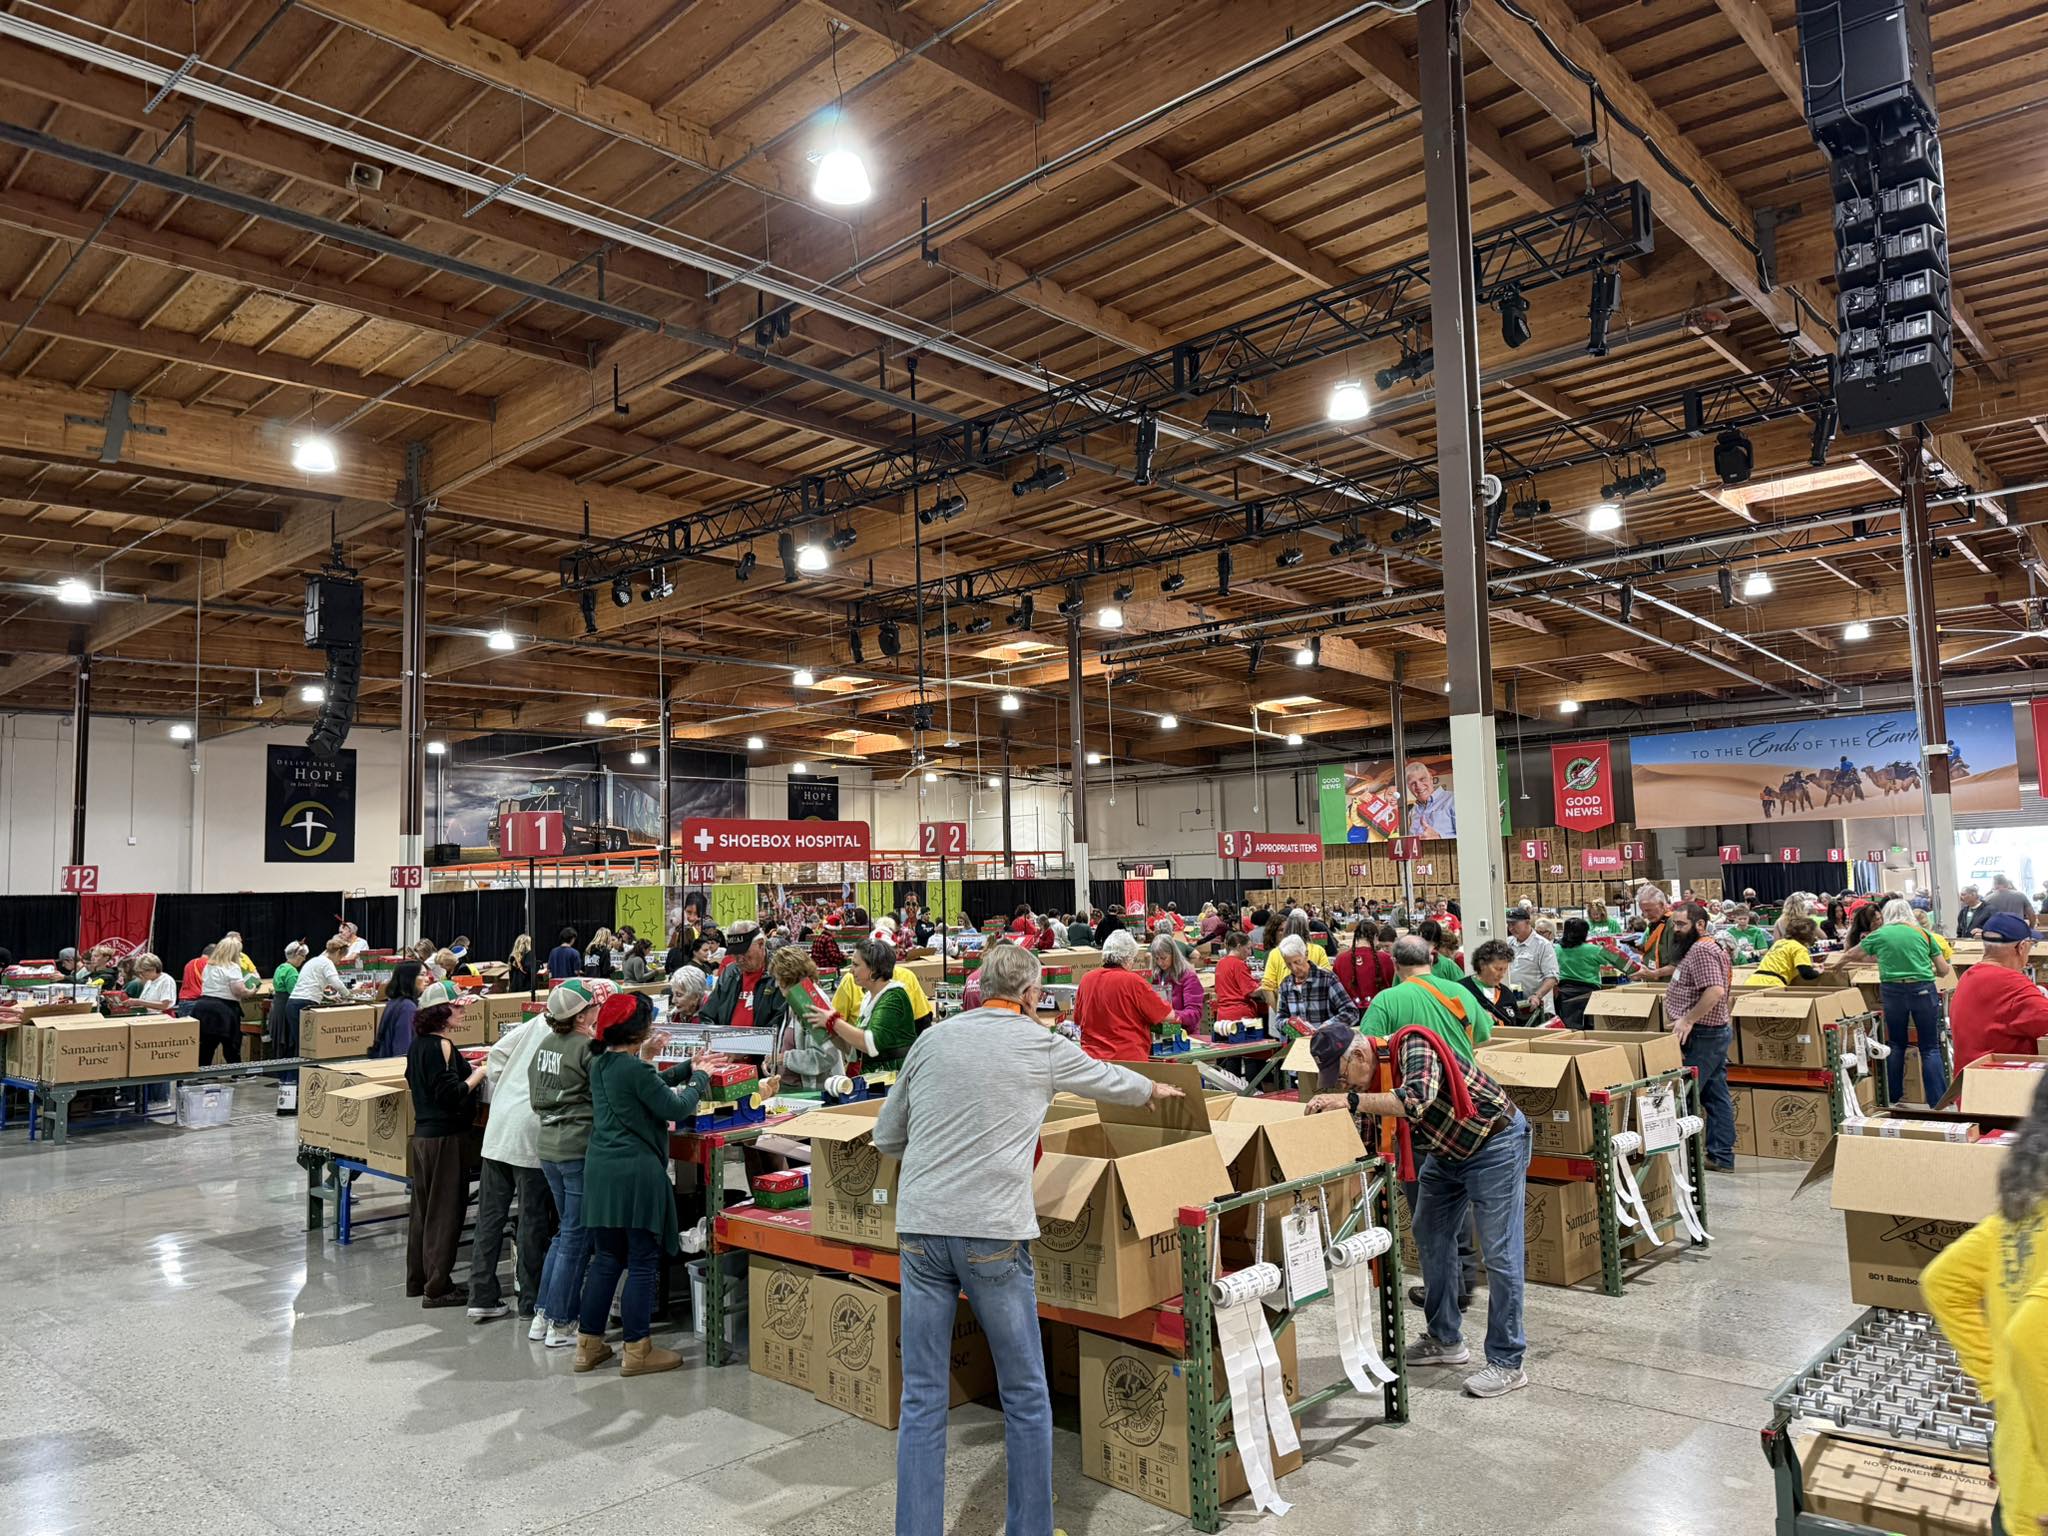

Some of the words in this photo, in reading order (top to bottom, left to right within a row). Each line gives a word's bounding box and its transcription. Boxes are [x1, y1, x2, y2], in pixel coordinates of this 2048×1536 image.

[1692, 750, 1709, 759] TO
[1715, 747, 1743, 757] THE
[1747, 727, 1804, 758] Ends
[1803, 741, 1823, 751] OF
[1830, 738, 1861, 748] THE
[276, 759, 336, 768] DELIVERING
[295, 767, 343, 781] HOPE
[804, 791, 832, 801] HOPE
[1566, 796, 1601, 807] GOOD
[1565, 806, 1603, 817] NEWS!
[506, 817, 513, 852] 1
[535, 816, 547, 851] 1
[925, 826, 936, 853] 2
[949, 825, 960, 853] 2
[719, 834, 791, 848] SHOEBOX
[795, 834, 861, 848] HOSPITAL
[1224, 833, 1234, 855] 3
[1244, 833, 1252, 855] 3
[1255, 843, 1299, 853] APPROPRIATE
[1299, 843, 1318, 853] ITEMS
[1394, 839, 1403, 857] 4
[1412, 838, 1418, 857] 4
[1526, 842, 1536, 858] 5
[1543, 842, 1548, 857] 5
[1624, 844, 1633, 859] 6
[1722, 847, 1731, 861] 7
[1783, 848, 1791, 861] 8
[1831, 849, 1838, 861] 9
[1870, 850, 1881, 861] 10
[1917, 851, 1927, 861] 11
[402, 867, 420, 886] 13
[690, 865, 699, 881] 14
[701, 865, 714, 881] 14
[871, 865, 881, 879] 15
[883, 865, 893, 879] 15
[1015, 864, 1025, 878] 16
[1026, 864, 1035, 878] 16
[1135, 864, 1144, 875] 17
[1267, 865, 1276, 875] 18
[1350, 865, 1359, 875] 19
[1416, 865, 1426, 875] 20
[72, 868, 95, 889] 12
[391, 868, 399, 886] 13
[320, 1022, 373, 1035] Samaritan's
[134, 1036, 196, 1050] Samaritan's
[335, 1034, 360, 1044] Purse
[61, 1041, 126, 1056] Samaritan's
[151, 1049, 181, 1060] Purse
[78, 1055, 109, 1066] Purse
[1150, 1231, 1181, 1258] Purs
[1868, 1272, 1884, 1281] 801
[1887, 1275, 1919, 1286] Bambo
[1108, 1361, 1129, 1412] Samaritan's
[1128, 1360, 1150, 1384] Purse
[1130, 1404, 1160, 1430] OPERATION
[1103, 1444, 1111, 1461] BOY
[1139, 1458, 1147, 1475] GIRL
[1880, 1463, 1956, 1481] COMMERCIAL
